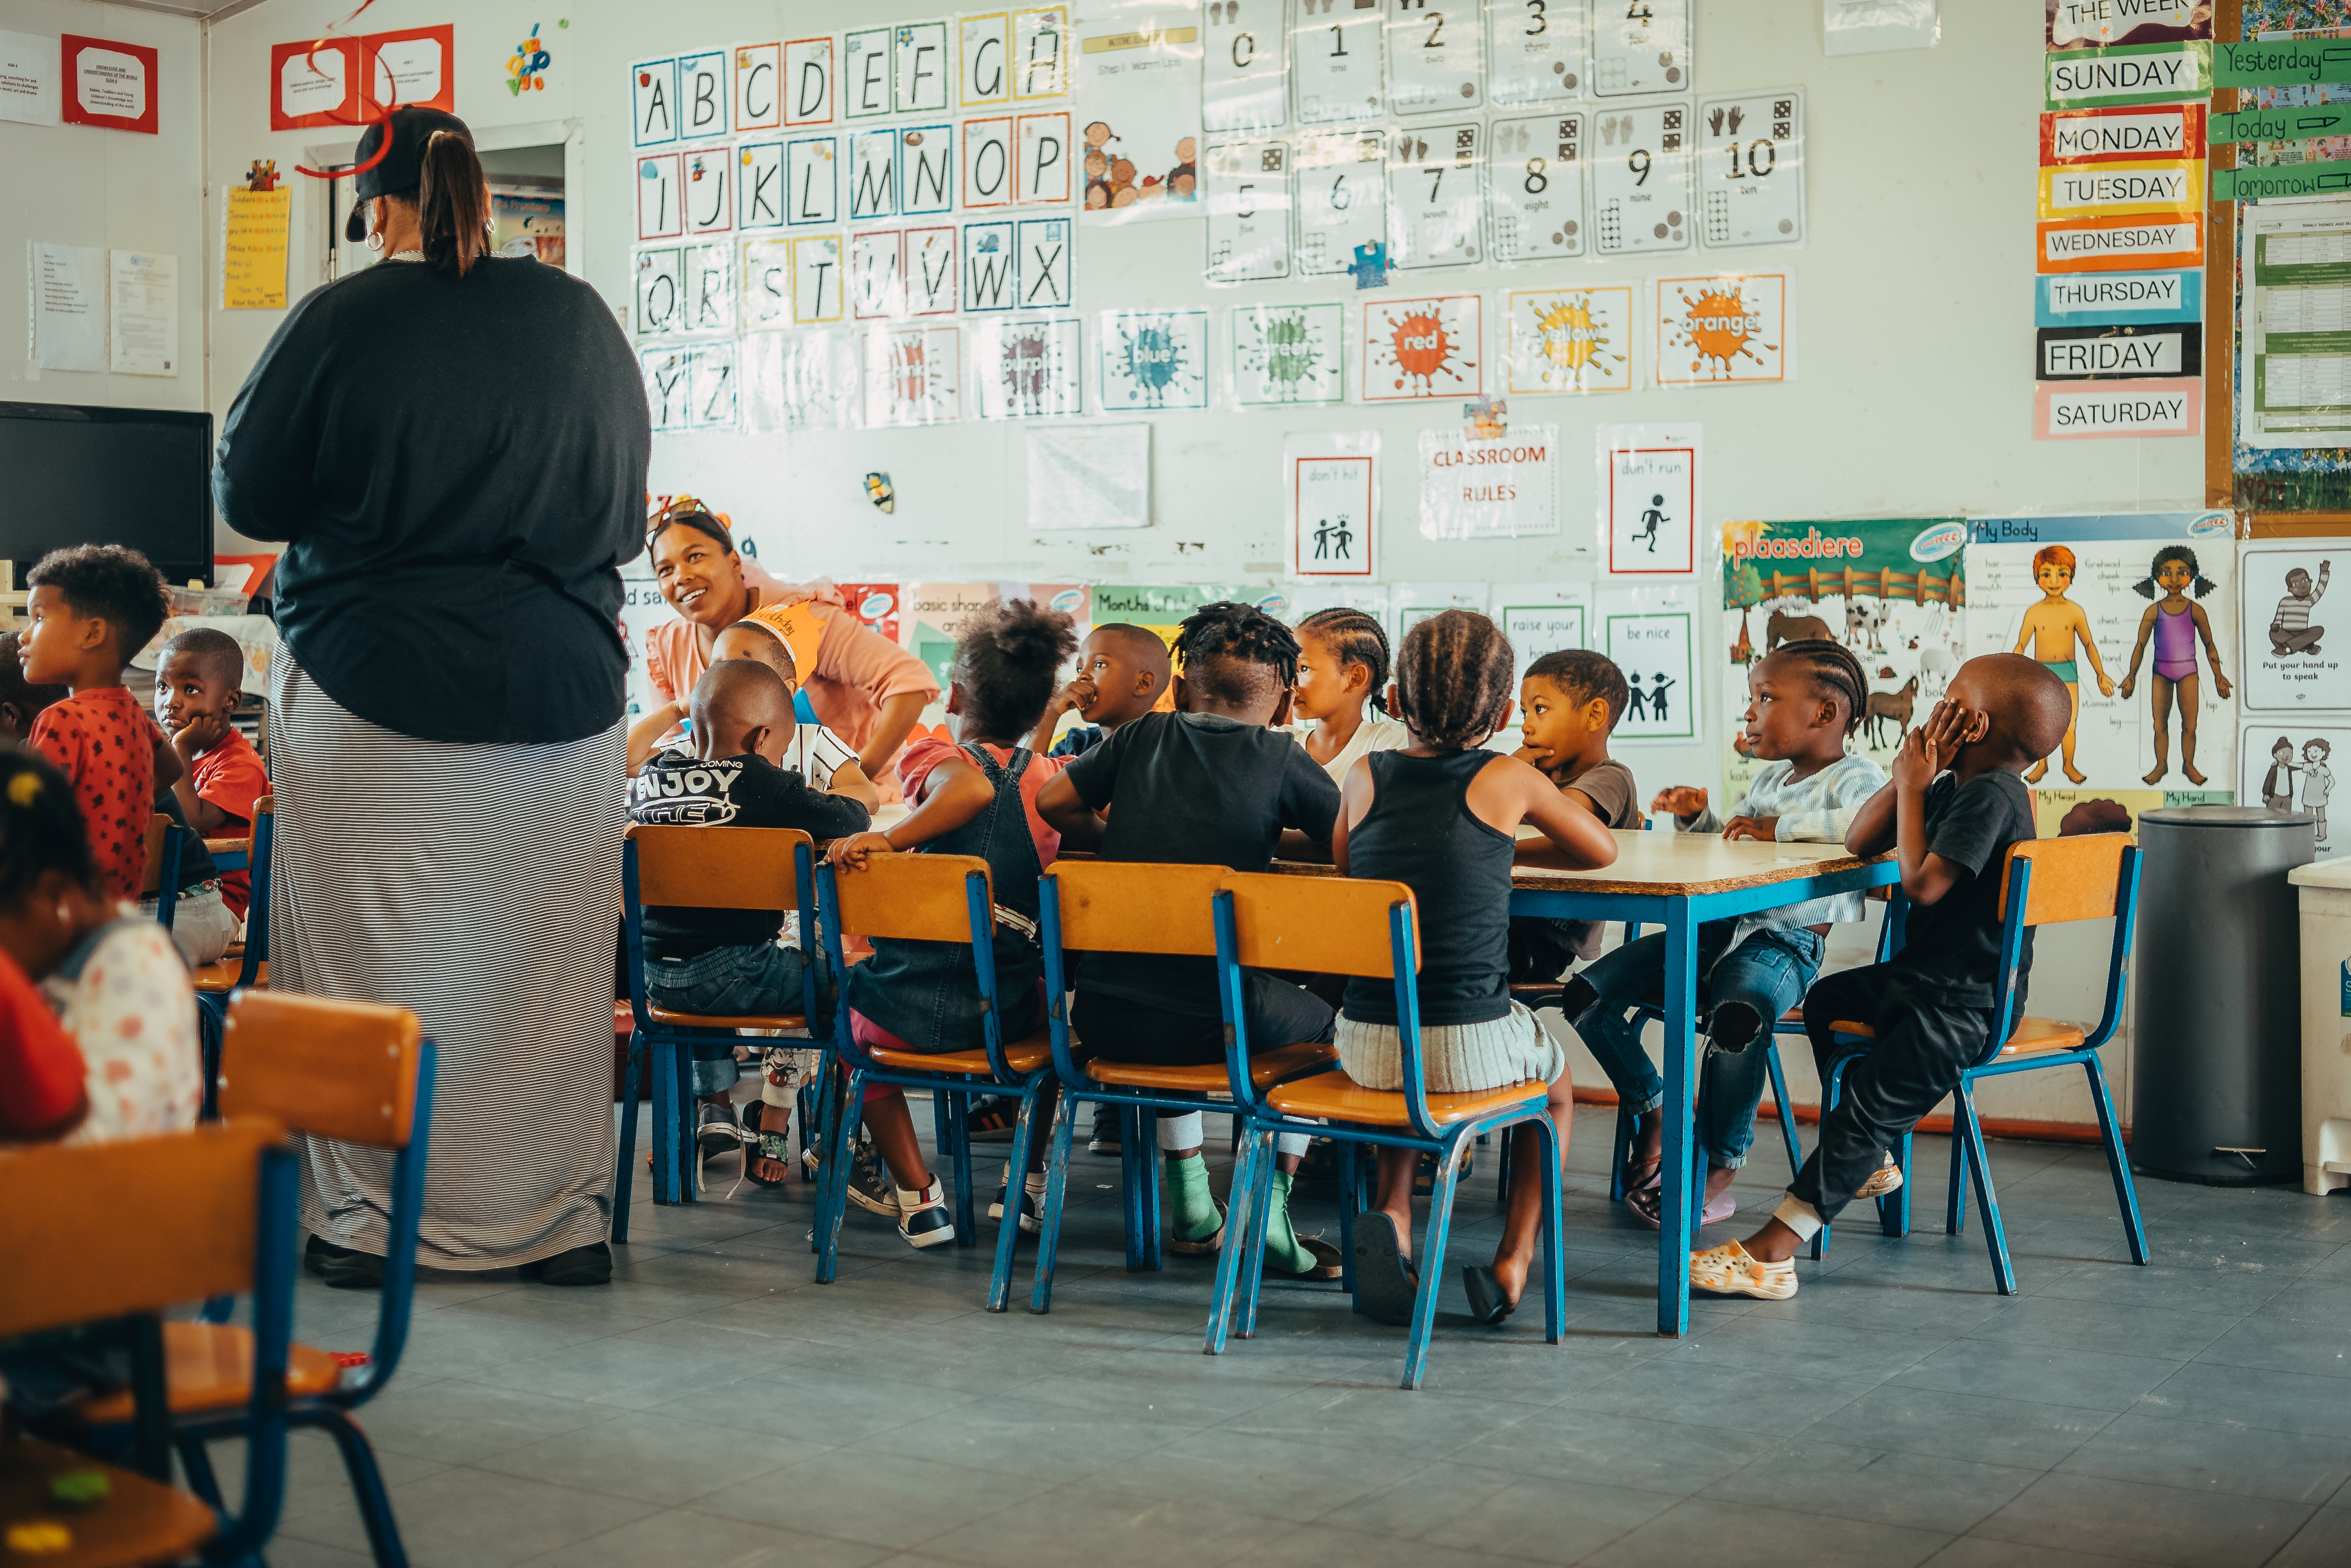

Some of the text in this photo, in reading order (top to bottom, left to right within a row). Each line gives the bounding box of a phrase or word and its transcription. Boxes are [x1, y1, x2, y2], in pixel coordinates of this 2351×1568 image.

[1525, 0, 1547, 35] 3
[1627, 0, 1652, 27] 4
[2067, 1, 2111, 24] THE
[1330, 24, 1348, 57] 1
[1423, 12, 1446, 48] 2
[1233, 33, 1253, 68] 0
[2223, 43, 2322, 81] Yesterday
[645, 32, 1058, 134] A B C D E F G H
[2056, 59, 2183, 91] SUNDAY
[2221, 111, 2286, 140] Today
[2058, 124, 2180, 154] MONDAY
[1628, 149, 1651, 186] 9
[1726, 138, 1775, 179] 10
[659, 136, 1060, 231] I J K L M N O P
[1424, 169, 1444, 203] 7
[1524, 157, 1548, 194] 8
[2226, 167, 2316, 198] Tomorrow
[1238, 185, 1255, 218] 5
[1331, 175, 1351, 210] 6
[1629, 192, 1652, 203] nine
[2064, 176, 2182, 202] TUESDAY
[1523, 199, 1550, 212] eight
[2052, 227, 2177, 253] WEDNESDAY
[647, 274, 675, 327] Q
[700, 268, 720, 323] R
[760, 267, 783, 322] S
[809, 262, 833, 317] T
[921, 251, 950, 307] V
[971, 254, 1010, 307] W
[1027, 243, 1063, 303] X
[2054, 279, 2176, 305] THURSDAY
[1539, 322, 1600, 349] yellow
[1681, 315, 1758, 338] orange
[1132, 337, 1171, 365] blue
[1403, 330, 1438, 352] red
[2049, 340, 2163, 371] FRIDAY
[655, 368, 680, 425] Y
[2056, 399, 2184, 425] SATURDAY
[1433, 446, 1546, 468] CLASSROOM
[1658, 462, 1682, 475] run
[1309, 466, 1358, 483] don't hit
[1462, 484, 1517, 502] RULES
[1976, 520, 1997, 542] My
[2002, 520, 2038, 542] Body
[1733, 526, 1864, 571] plaasdiere
[2085, 558, 2120, 569] forehead
[913, 593, 984, 613] basic shap
[1098, 593, 1150, 612] Months
[1968, 599, 2001, 609] shoulder
[756, 610, 795, 637] irthday
[1513, 618, 1575, 638] raise your
[1627, 624, 1671, 640] be nice
[2097, 615, 2120, 625] chest
[2099, 635, 2120, 645] elbow
[2102, 652, 2121, 663] hand
[2262, 660, 2338, 671] Put your hand up
[2294, 672, 2318, 683] speak
[1925, 687, 1945, 698] bok
[2081, 698, 2116, 709] stomach
[2206, 700, 2218, 713] hip
[636, 769, 742, 801] ENJOY
[1729, 769, 1752, 781] kalk
[2038, 791, 2077, 805] My Head
[2166, 791, 2206, 806] My Hand
[633, 802, 710, 824] THE
